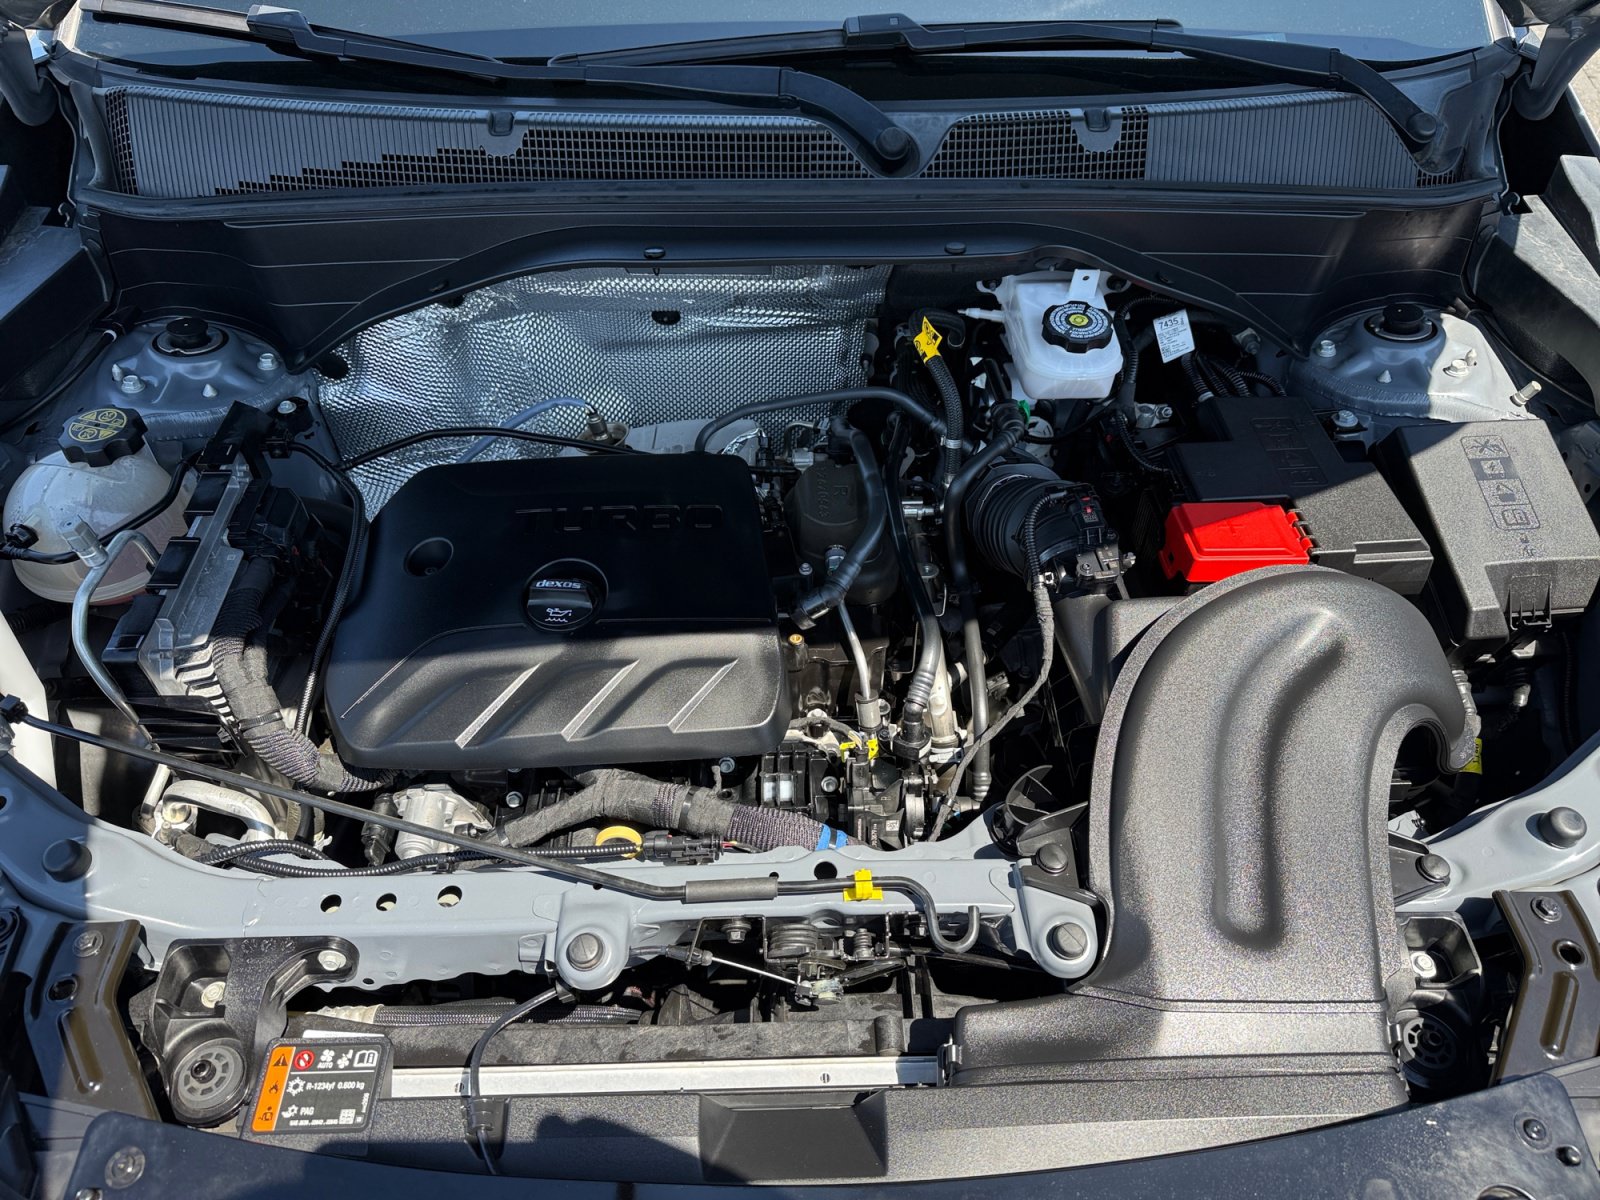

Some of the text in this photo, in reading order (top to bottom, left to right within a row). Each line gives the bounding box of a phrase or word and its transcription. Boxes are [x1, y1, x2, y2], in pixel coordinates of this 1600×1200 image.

[1158, 316, 1179, 329] 7435
[515, 504, 724, 535] TURBO
[536, 578, 582, 590] dexos
[317, 1061, 334, 1069] AUTO
[306, 1082, 336, 1091] R-1234yf
[356, 1080, 365, 1090] kg
[299, 1107, 315, 1116] PAG
